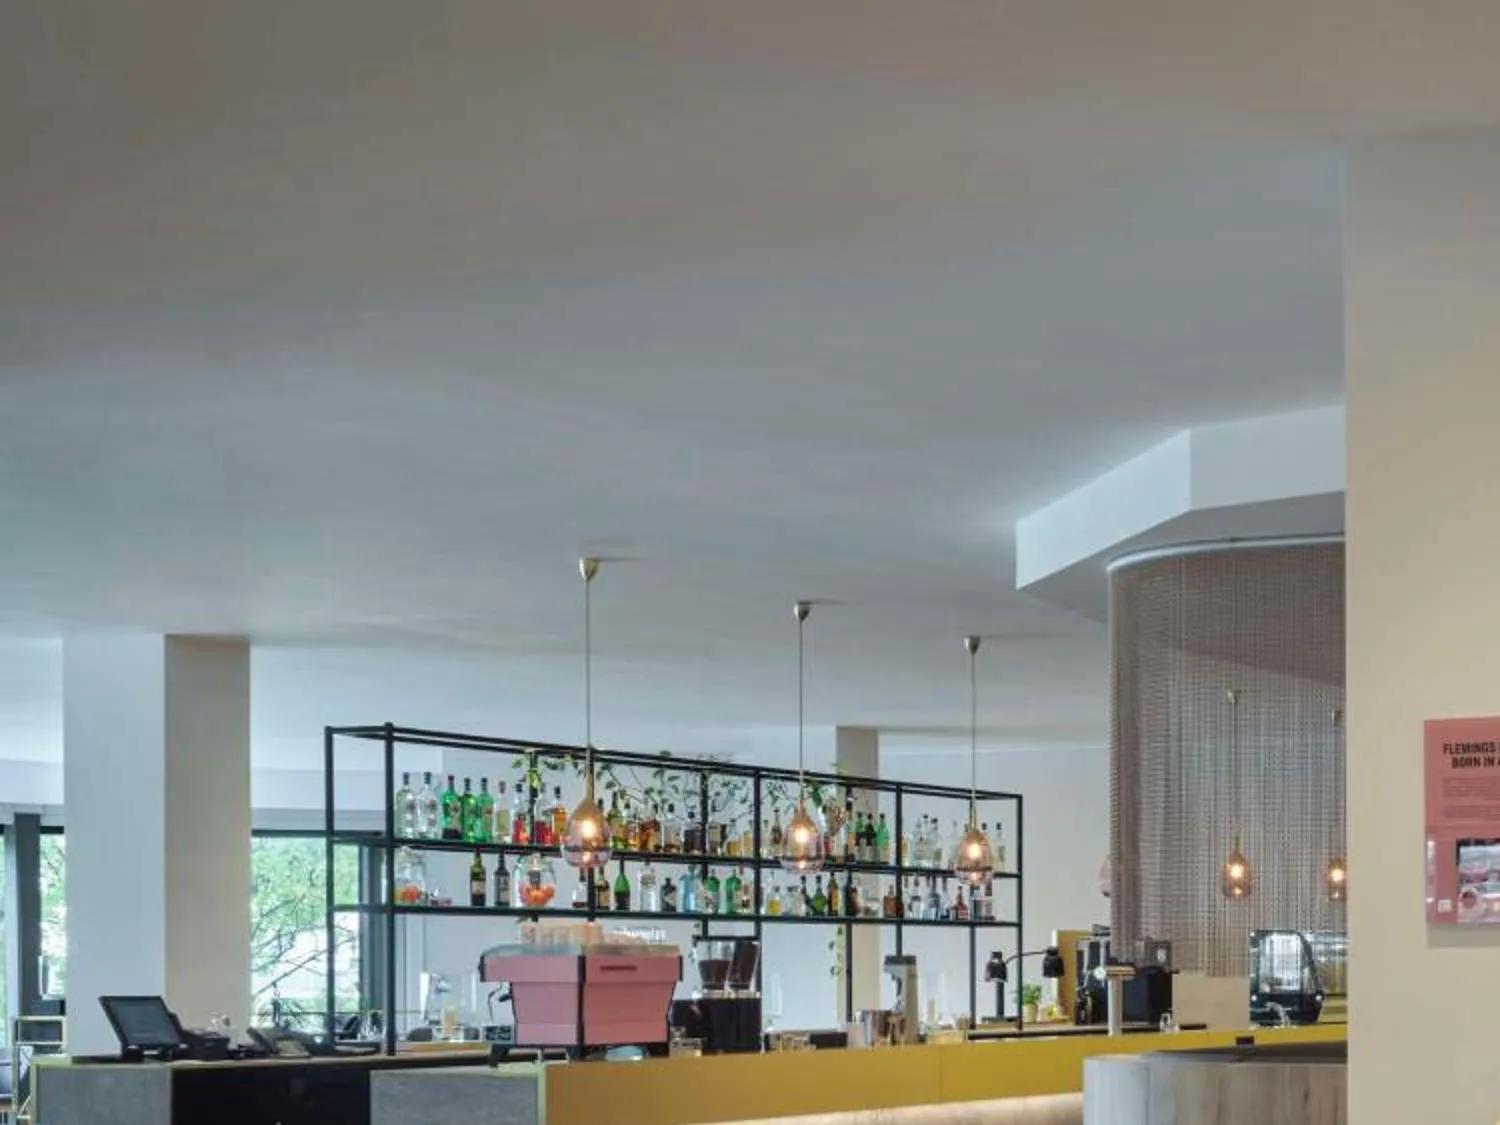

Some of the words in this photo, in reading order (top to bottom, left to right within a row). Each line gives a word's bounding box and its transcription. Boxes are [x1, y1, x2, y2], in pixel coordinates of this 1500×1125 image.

[1443, 742, 1497, 755] FLEMINGS
[1451, 756, 1481, 768] BORN
[1483, 756, 1495, 767] IN
